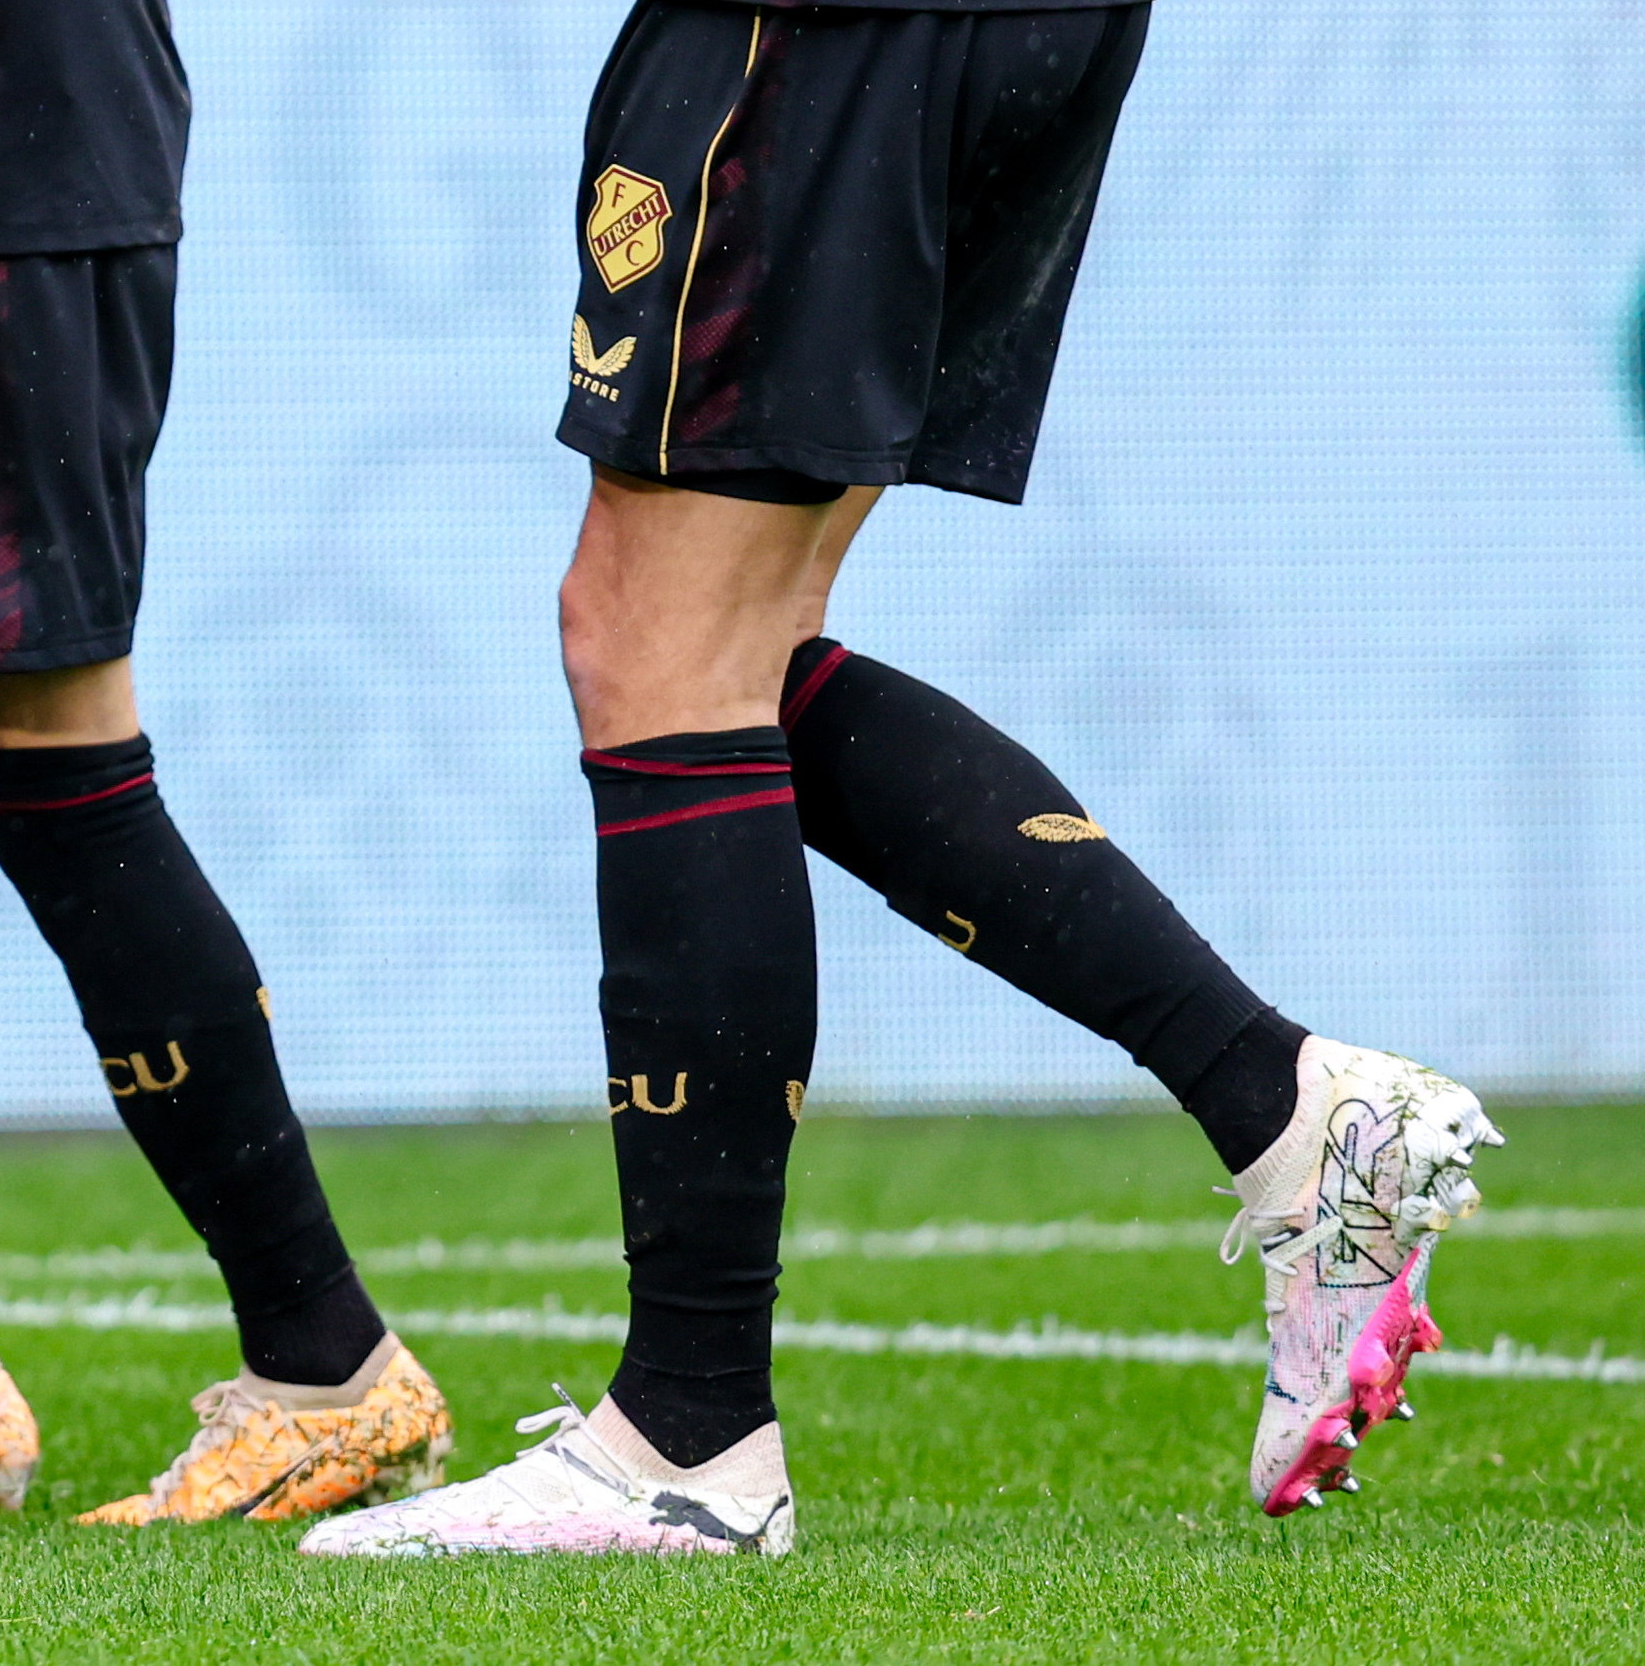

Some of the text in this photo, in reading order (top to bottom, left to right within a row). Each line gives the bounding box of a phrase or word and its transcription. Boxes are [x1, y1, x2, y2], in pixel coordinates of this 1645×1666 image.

[612, 182, 626, 208] F
[594, 193, 664, 257] UTRECHT
[626, 241, 644, 265] C
[570, 371, 620, 402] STORE
[99, 1041, 189, 1097] CU
[608, 1071, 687, 1116] CU
